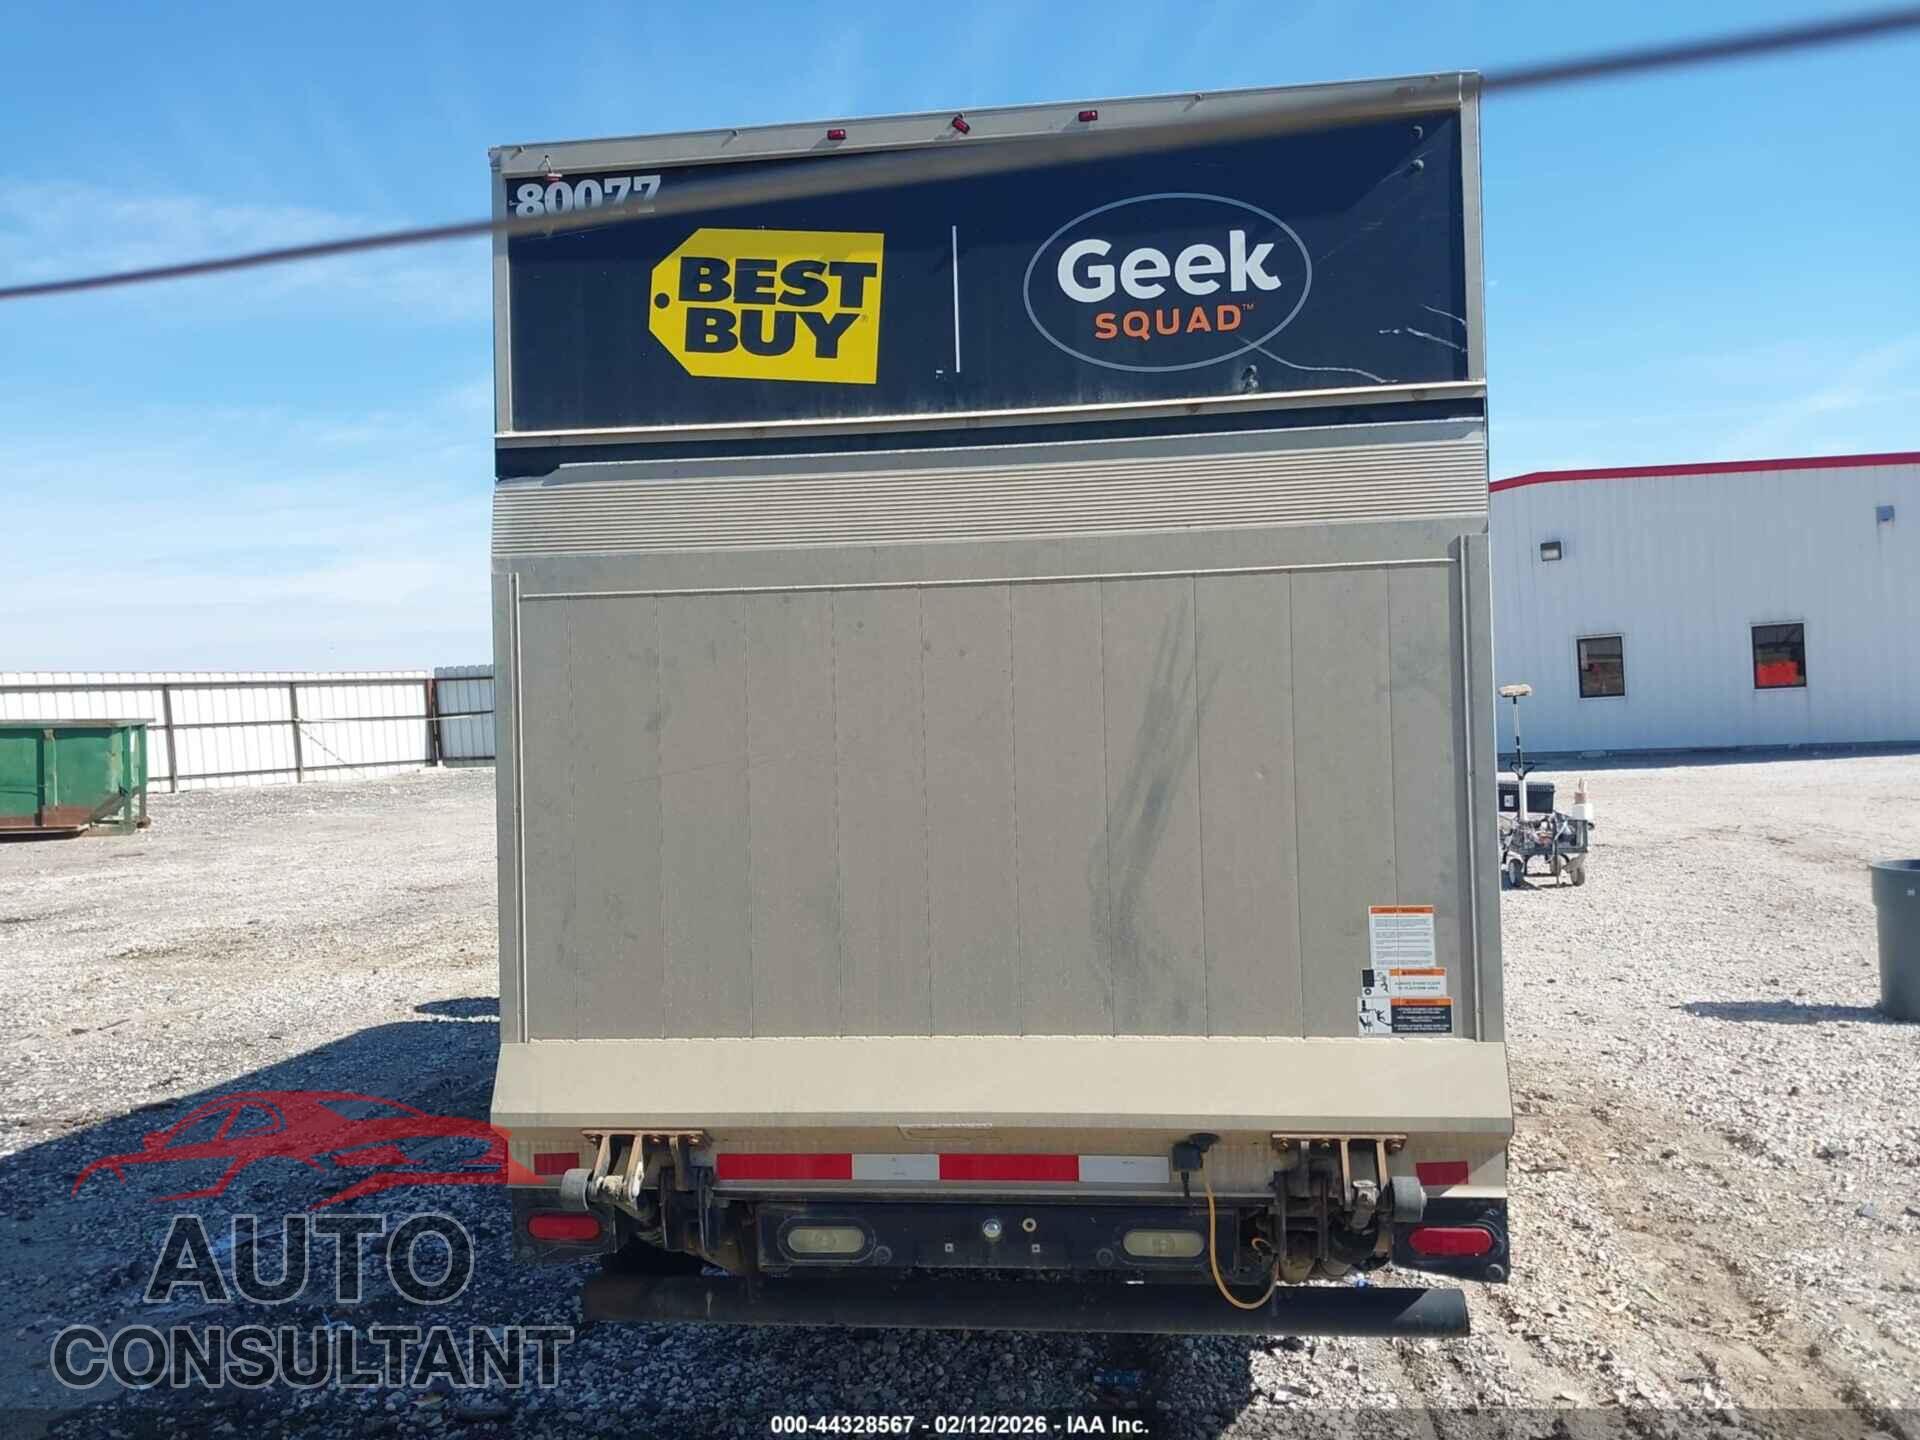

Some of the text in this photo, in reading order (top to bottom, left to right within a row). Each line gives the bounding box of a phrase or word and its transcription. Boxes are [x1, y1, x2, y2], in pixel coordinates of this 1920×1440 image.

[515, 174, 662, 219] 80077
[678, 256, 878, 309] BEST
[1057, 230, 1282, 303] Geek
[684, 308, 861, 359] BUY
[1095, 303, 1241, 341] SQUAD
